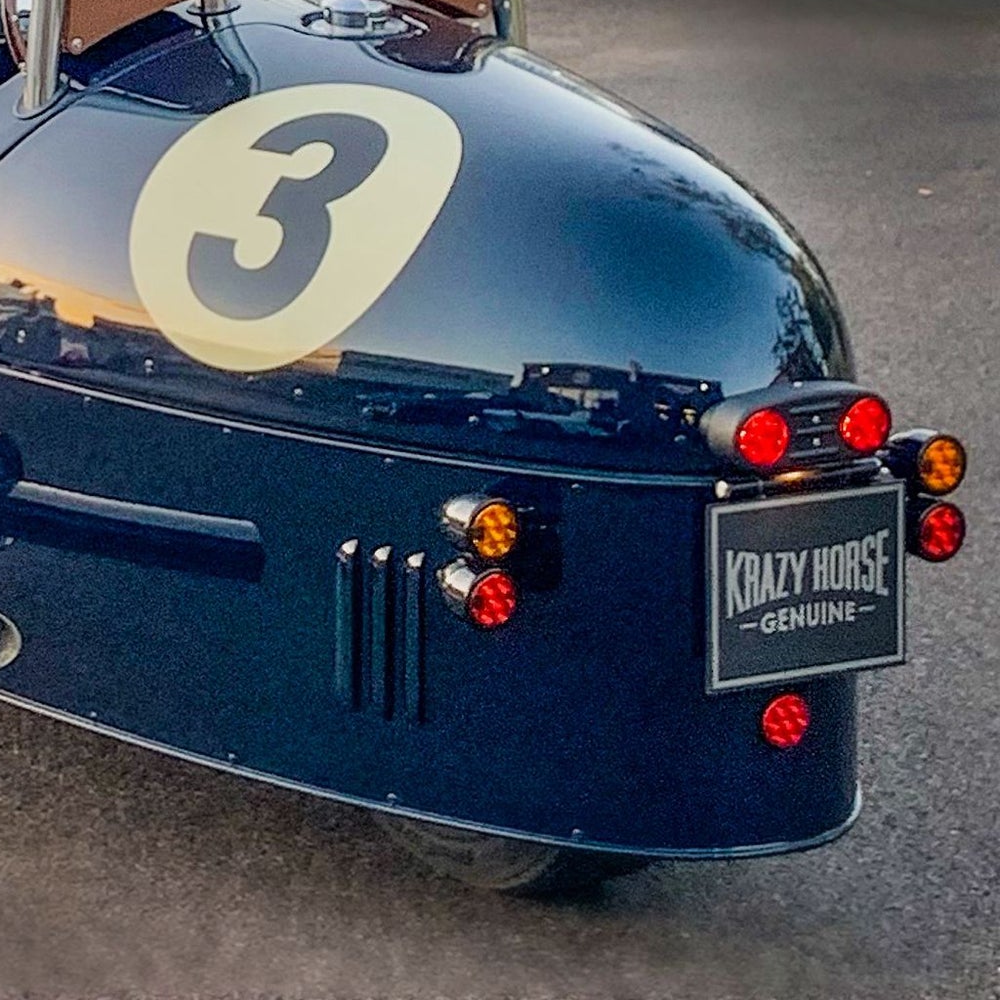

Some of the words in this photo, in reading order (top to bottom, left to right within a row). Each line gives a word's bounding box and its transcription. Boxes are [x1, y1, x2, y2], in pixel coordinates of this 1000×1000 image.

[187, 112, 389, 321] 3
[726, 549, 808, 619] KRAZY
[813, 528, 890, 597] HORSE
[759, 601, 857, 634] GENUINE
